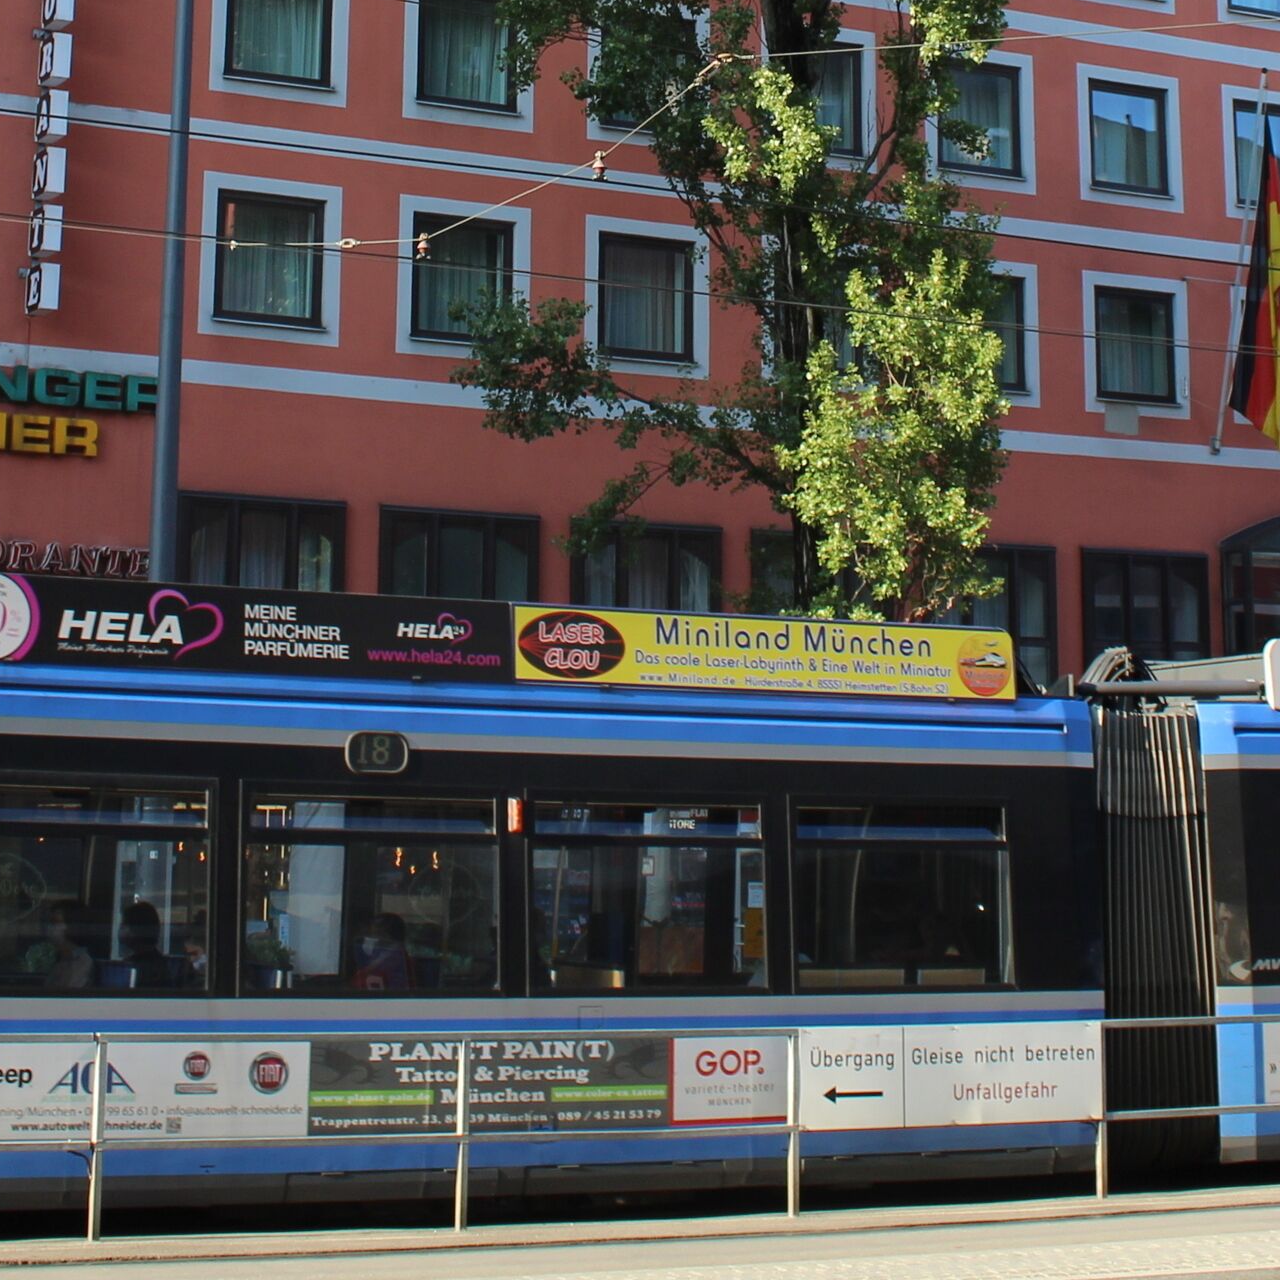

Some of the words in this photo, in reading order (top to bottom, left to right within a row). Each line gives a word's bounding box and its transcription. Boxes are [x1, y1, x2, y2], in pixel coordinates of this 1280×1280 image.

[244, 604, 297, 621] MEINE
[57, 609, 184, 645] HELA
[244, 620, 341, 641] MÜNCHNER
[538, 621, 606, 645] LASER
[656, 617, 789, 651] Miniland
[803, 624, 932, 657] München
[244, 638, 350, 660] PARFÜMERIE
[367, 648, 501, 667] www.hela24.com
[544, 648, 601, 670] CLOU
[635, 650, 660, 665] Das
[664, 652, 701, 667] coole
[705, 652, 804, 674] Laser-Labyrinth
[808, 659, 818, 672] &
[822, 660, 848, 673] Eine
[852, 660, 881, 674] Welt
[885, 662, 896, 674] in
[900, 662, 952, 677] Miniatur
[355, 733, 390, 765] 18
[368, 1041, 498, 1063] PLANT
[502, 1039, 615, 1062] PAIN(T)
[810, 1046, 896, 1072] Übergang
[910, 1046, 965, 1067] Gleise
[974, 1043, 1016, 1064] nicht
[1024, 1044, 1097, 1063] betreten
[259, 1064, 281, 1083] FIAT
[395, 1066, 462, 1085] Tatto
[474, 1066, 495, 1082] &
[498, 1064, 590, 1086] Piercing
[311, 1091, 432, 1105] www.planet-pain.de
[440, 1087, 545, 1105] München
[685, 1080, 775, 1095] varieté-theater
[953, 1081, 1059, 1104] Unfallgefahr
[122, 1106, 134, 1116] 65
[137, 1106, 150, 1116] 61
[166, 1104, 303, 1117] info@autowelt-schneider.de
[707, 1096, 753, 1107] MÜNCHEN
[11, 1119, 163, 1132] www.autowelthneider.de
[311, 1115, 419, 1130] Trappentreustr.
[488, 1111, 548, 1124] München
[557, 1110, 582, 1122] 089
[593, 1110, 611, 1121] 45
[612, 1110, 626, 1120] 21
[628, 1109, 644, 1120] 53
[646, 1108, 662, 1119] 79
